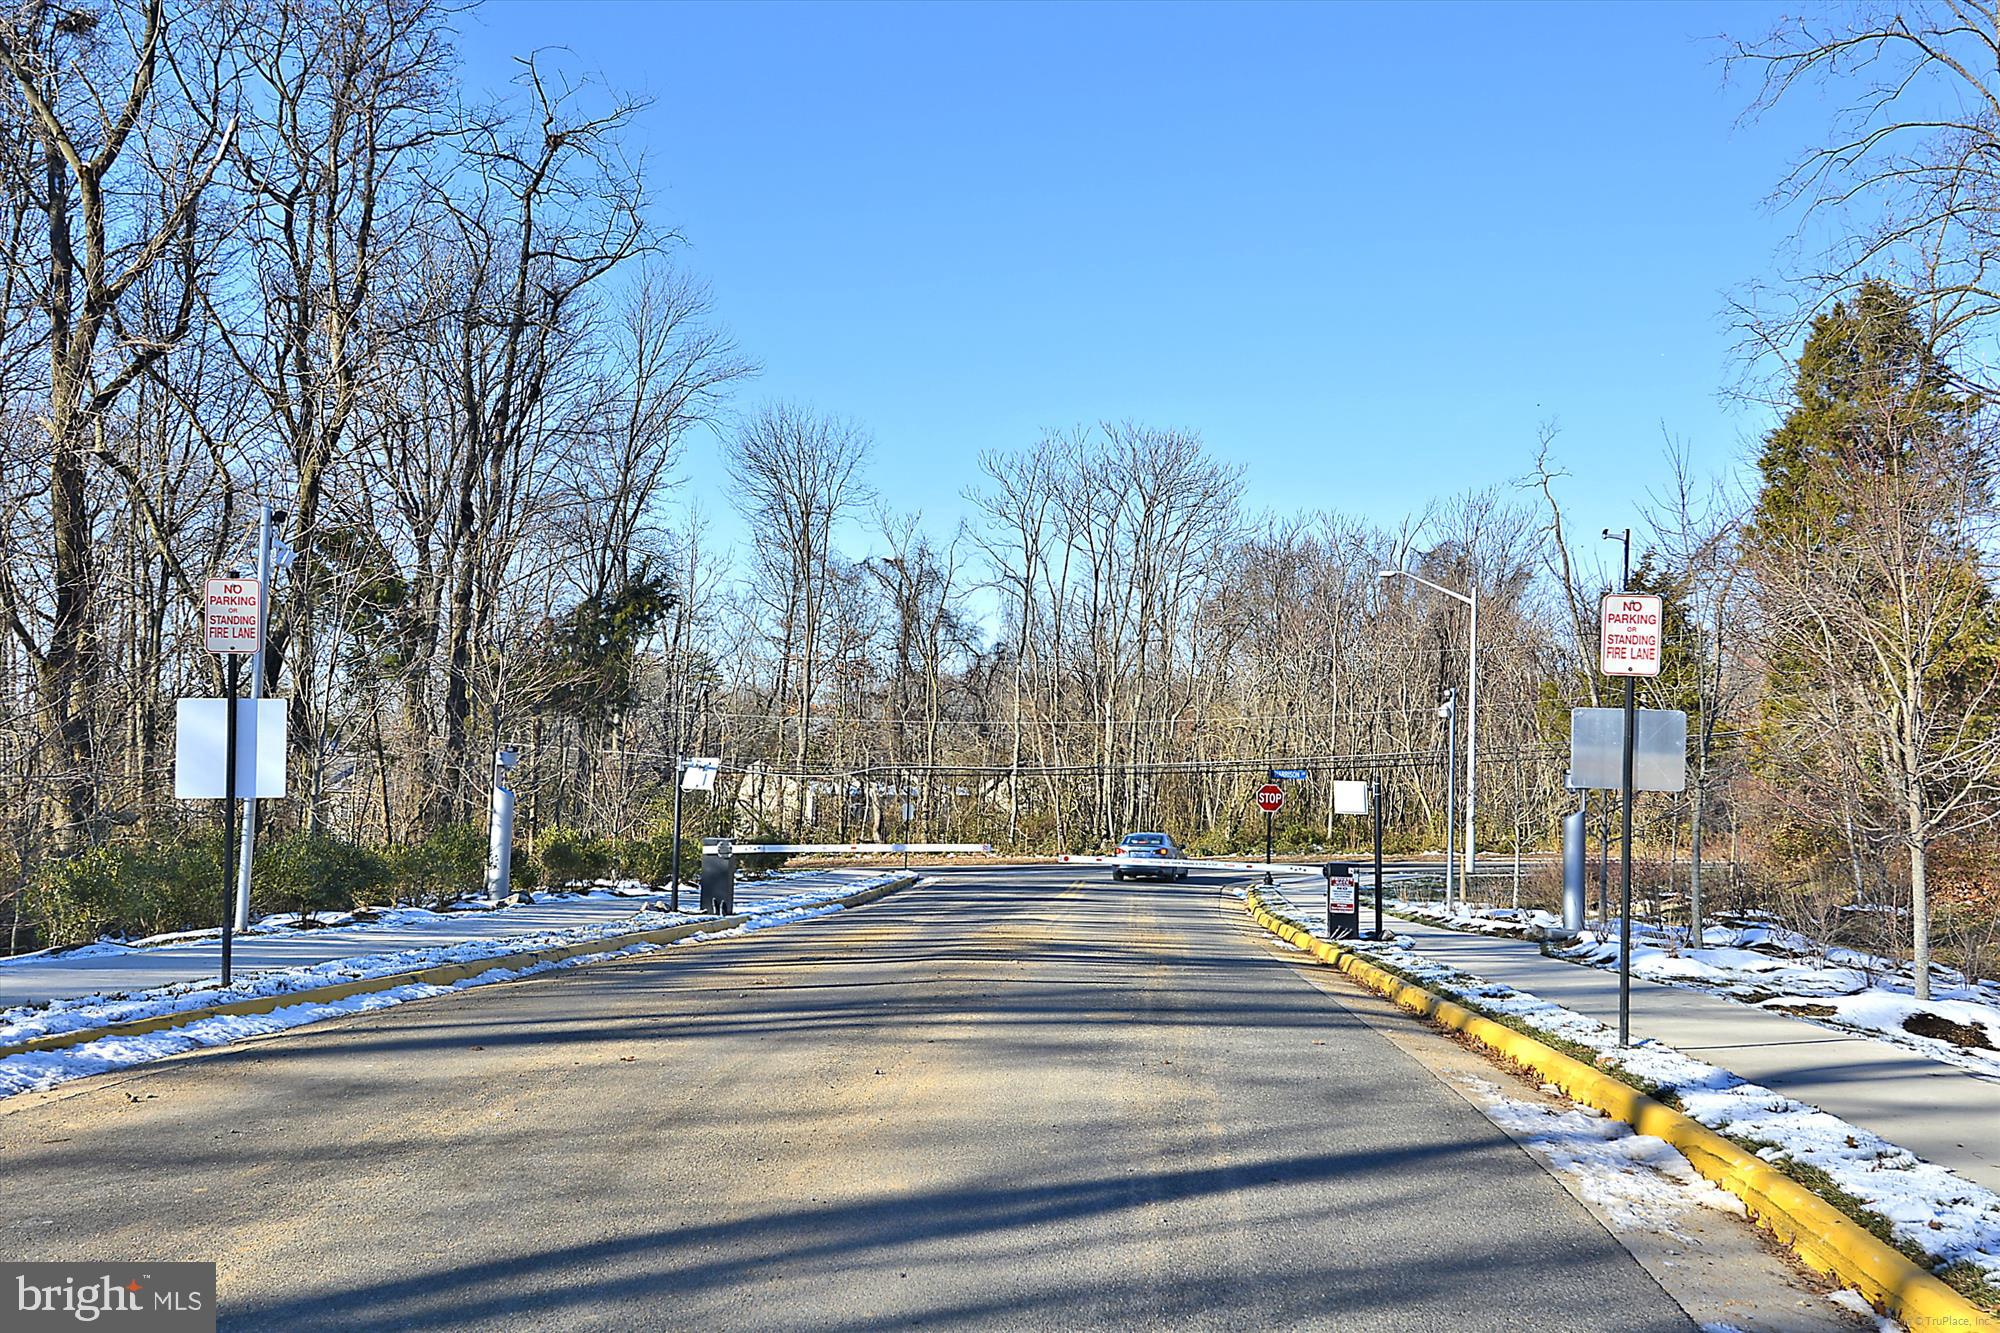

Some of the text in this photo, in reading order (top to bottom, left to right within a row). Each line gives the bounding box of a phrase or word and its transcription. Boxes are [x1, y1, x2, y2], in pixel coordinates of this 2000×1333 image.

[224, 584, 242, 594] NO
[209, 596, 256, 606] PARKING
[1623, 601, 1643, 612] NO
[209, 615, 256, 625] STANDING
[1607, 613, 1657, 625] PARKING
[209, 627, 256, 639] FIRE LANE
[1607, 634, 1656, 646] STANDING
[1606, 647, 1656, 660] FIRE LANE
[1259, 792, 1282, 804] STOP
